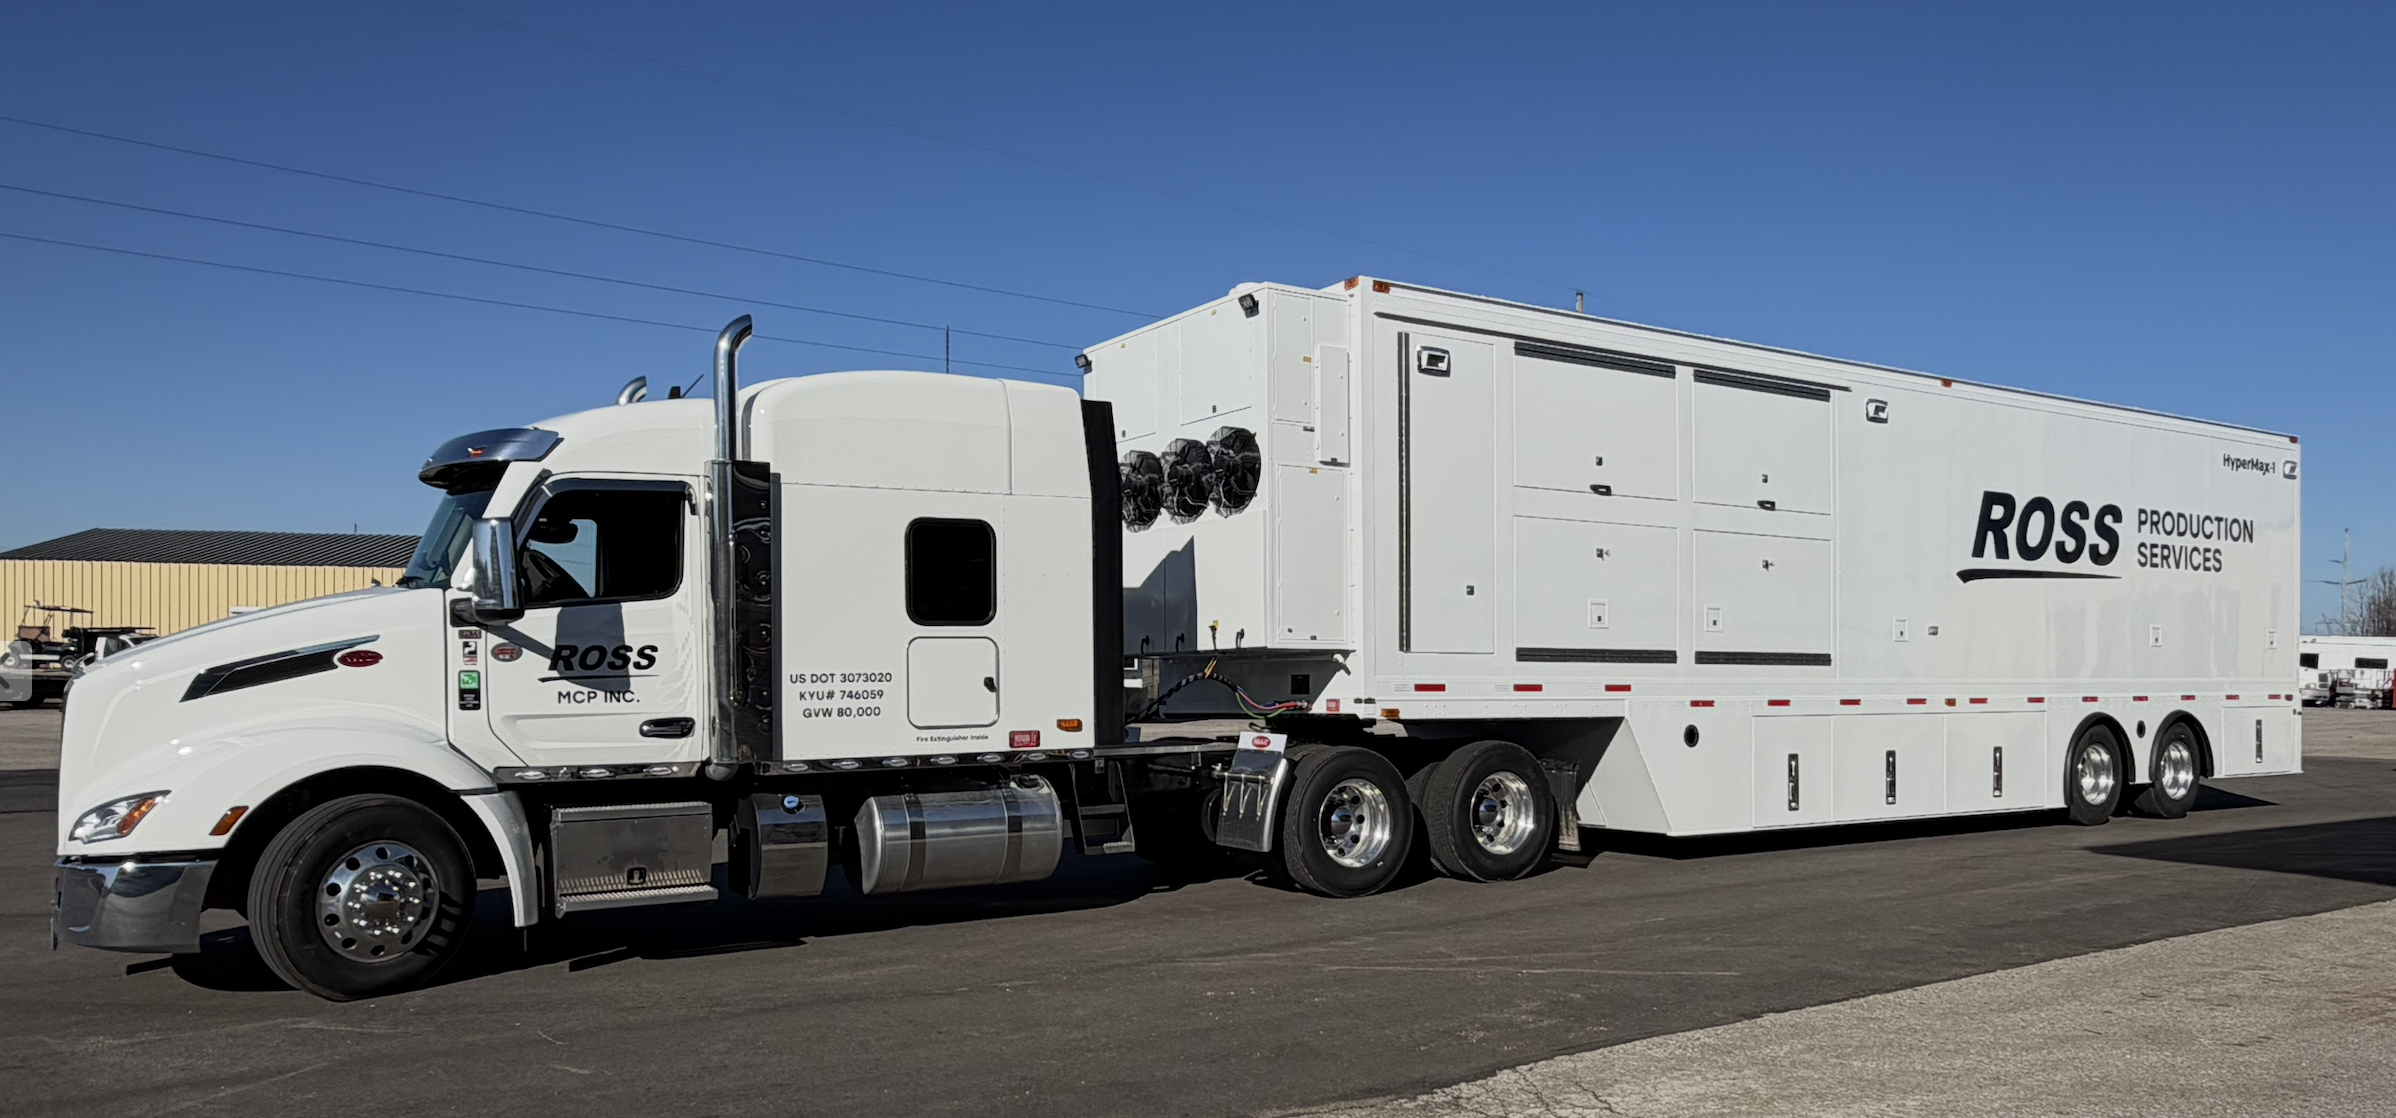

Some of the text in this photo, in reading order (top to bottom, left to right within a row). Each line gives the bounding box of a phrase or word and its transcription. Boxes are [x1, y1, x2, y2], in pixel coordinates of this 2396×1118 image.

[1971, 490, 2123, 566] ROSS
[2137, 508, 2254, 543] PRODUCTION
[2137, 542, 2223, 573] SERVICES
[548, 644, 659, 671] ROSS
[790, 672, 893, 684] US DOT 3073020
[557, 690, 640, 704] MCP INC.
[799, 689, 884, 701] KYU# 746059
[802, 706, 881, 719] GVW 80,000
[930, 735, 969, 743] Extinguisher
